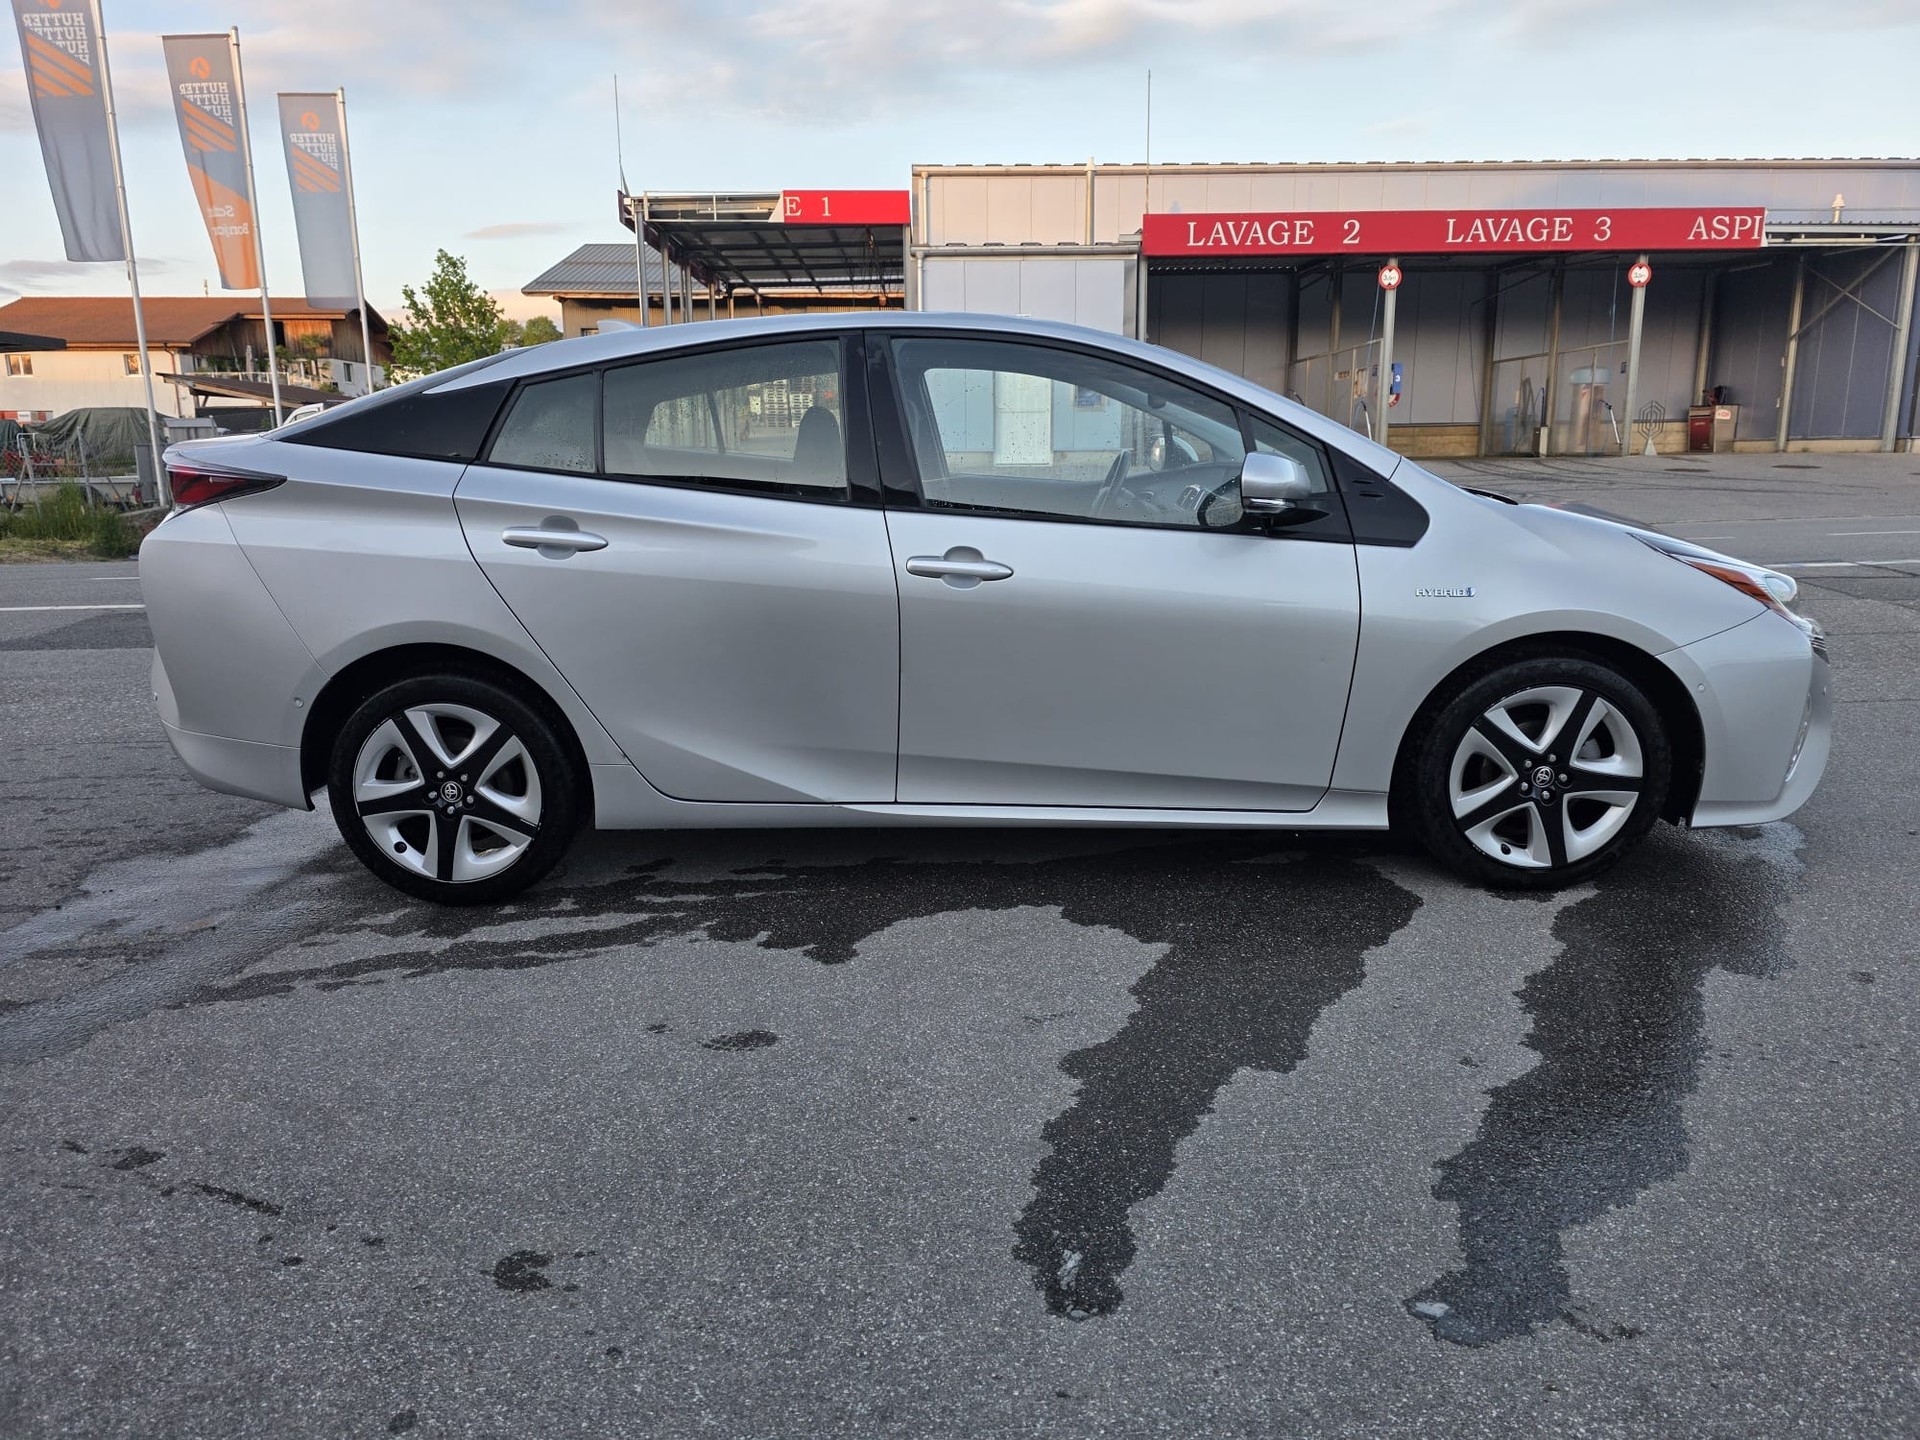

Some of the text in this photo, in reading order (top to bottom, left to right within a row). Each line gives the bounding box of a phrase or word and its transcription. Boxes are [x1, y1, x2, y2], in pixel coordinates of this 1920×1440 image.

[784, 196, 832, 217] E 1
[1187, 219, 1361, 246] LAVAGE 2
[1445, 216, 1612, 243] LAVAGE 3
[1686, 215, 1763, 240] ASPI
[1395, 374, 1401, 382] 3
[1415, 587, 1467, 597] HYBRID
